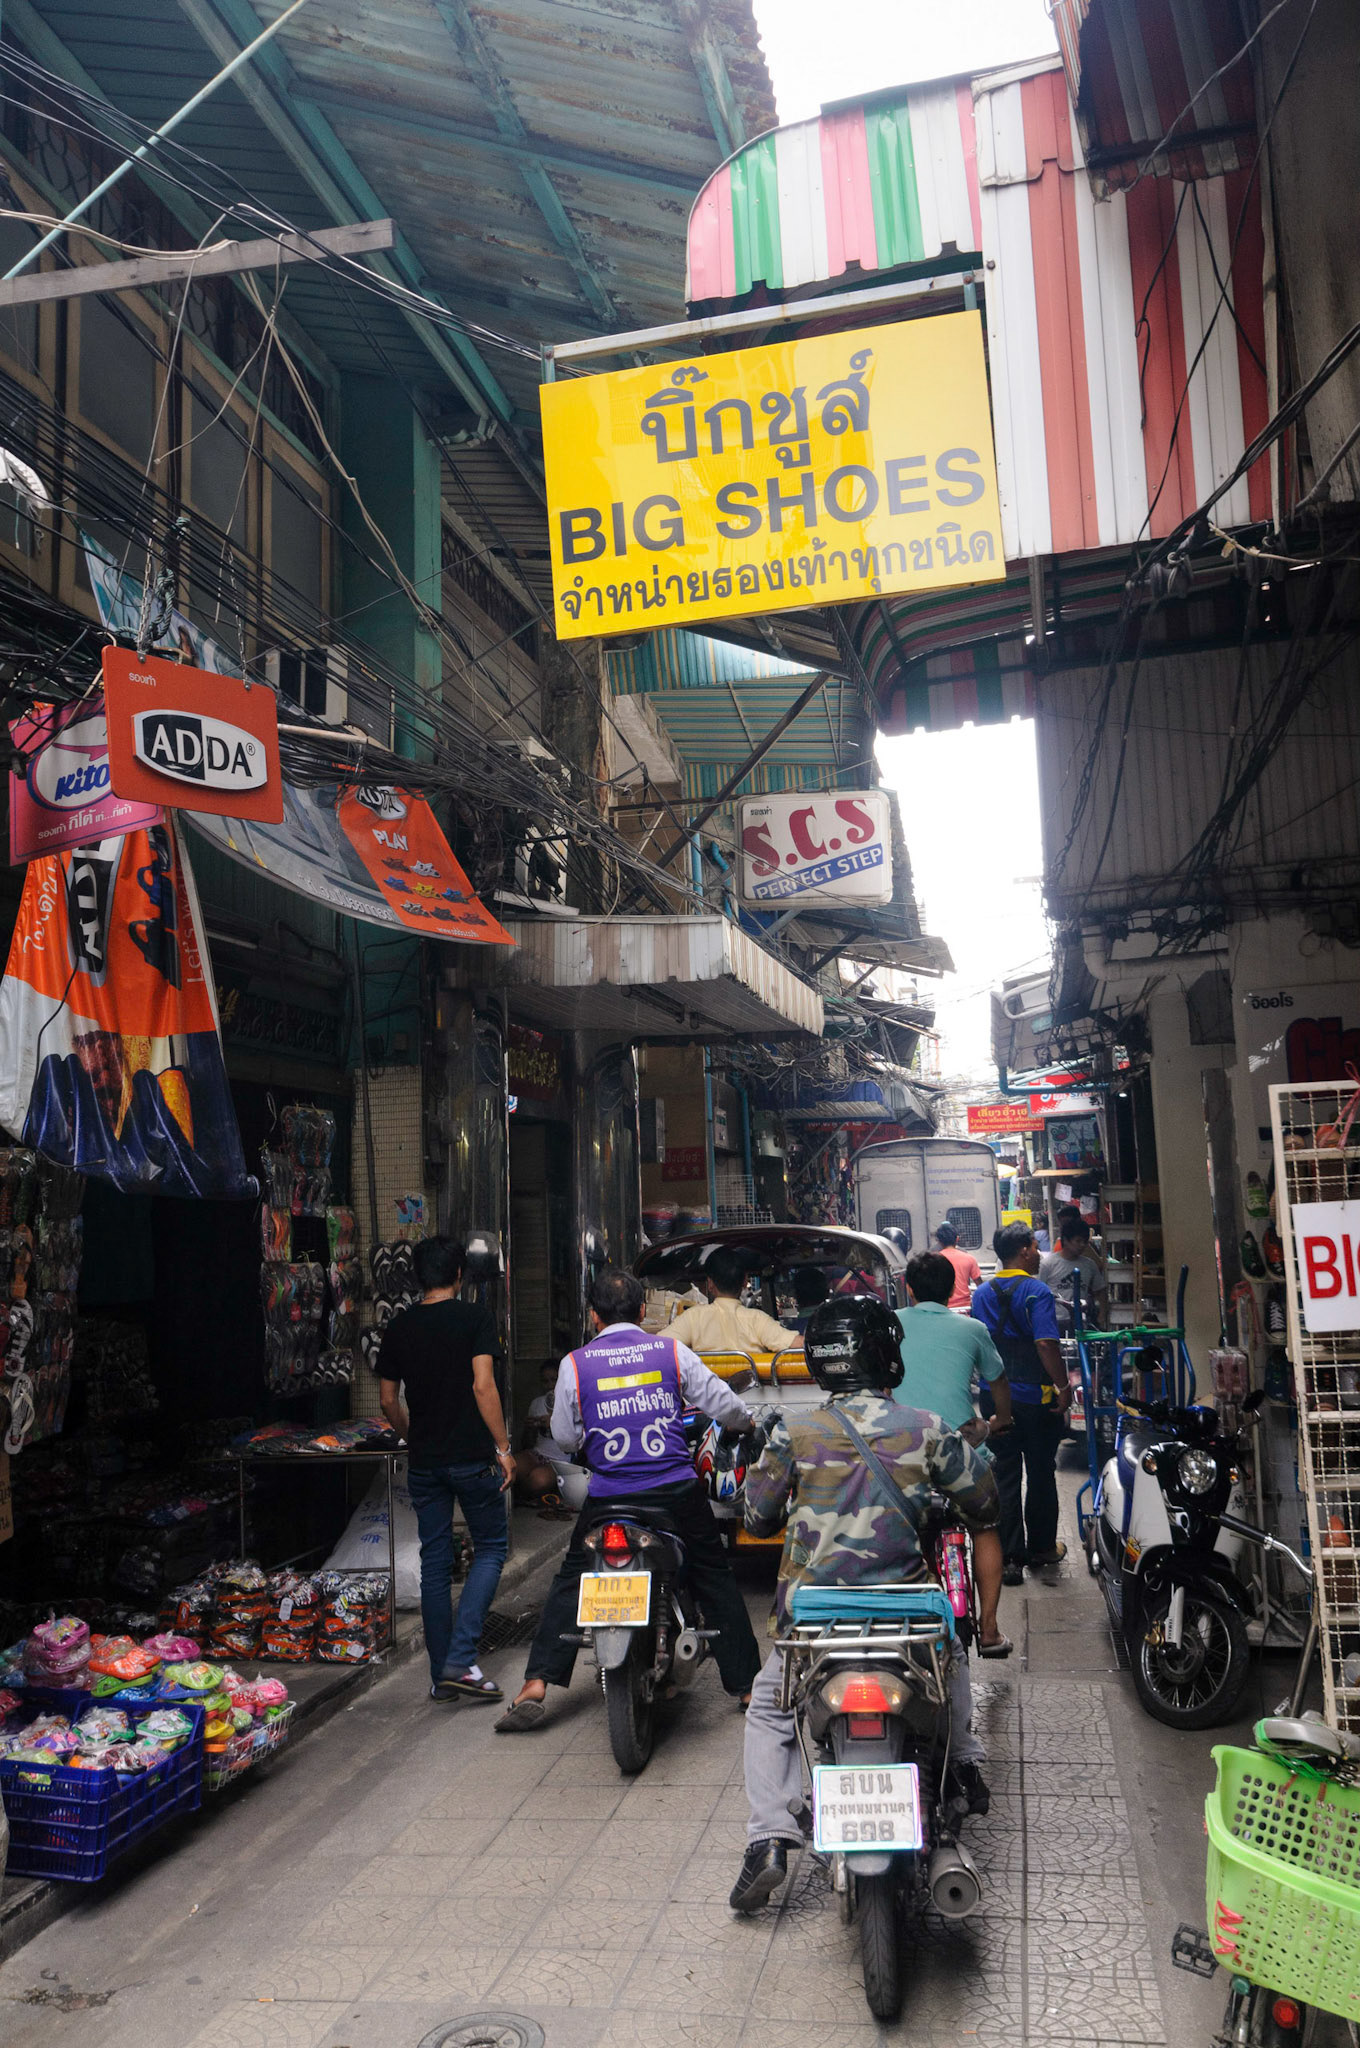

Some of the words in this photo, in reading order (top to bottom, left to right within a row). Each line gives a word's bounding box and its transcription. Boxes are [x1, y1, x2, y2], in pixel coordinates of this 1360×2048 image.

[641, 348, 873, 469] บิ๊กชูส์
[559, 495, 686, 565] BIG
[715, 447, 986, 540] SHOES
[560, 522, 995, 621] จำหน่ายรองเท้าทุกชนิด
[150, 723, 253, 778] ADDA
[55, 763, 111, 801] Kito
[38, 823, 67, 840] รองเท้า
[68, 809, 96, 831] กีโต้
[372, 829, 409, 851] PLAY
[743, 799, 875, 877] S.C.S
[756, 863, 832, 900] PERFECT
[836, 848, 882, 874] STEP
[1303, 1234, 1360, 1299] BI
[584, 1343, 653, 1358] ปากซอยเพชรเกษม
[654, 1341, 665, 1350] 48
[608, 1353, 644, 1367] (กลางวัน)
[596, 1387, 675, 1420] เขตภาษีเจริญ
[821, 1801, 914, 1819] กรุงเทพมหานคร
